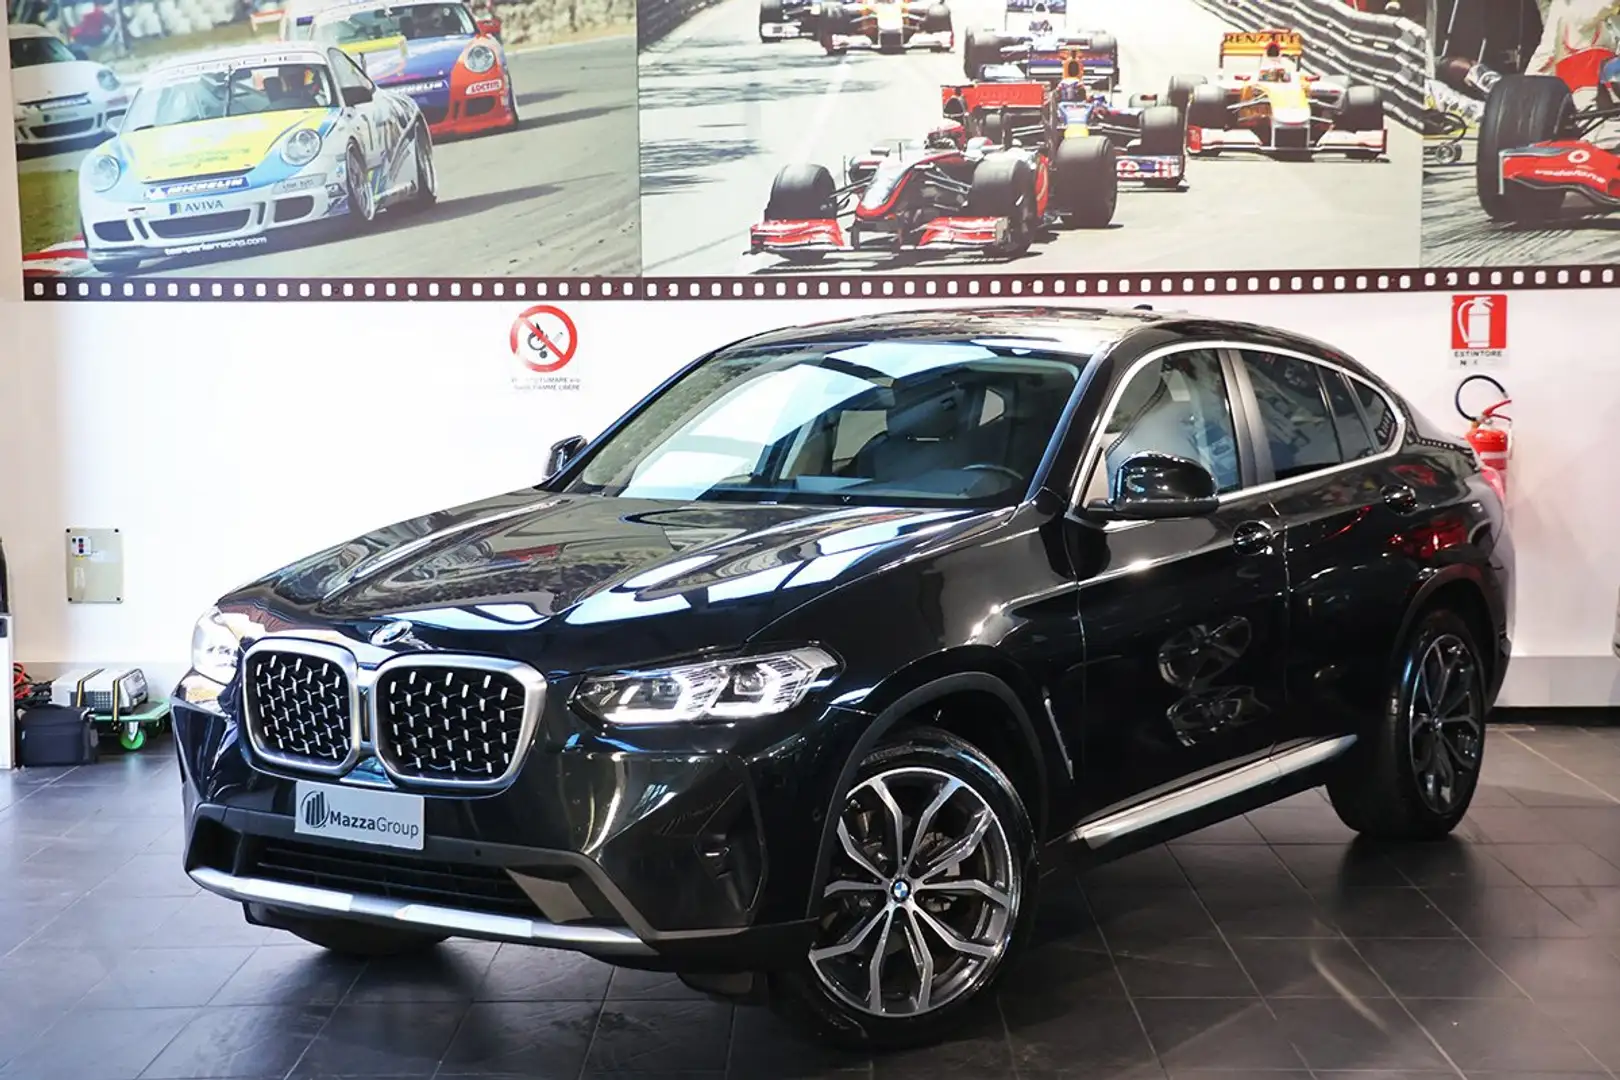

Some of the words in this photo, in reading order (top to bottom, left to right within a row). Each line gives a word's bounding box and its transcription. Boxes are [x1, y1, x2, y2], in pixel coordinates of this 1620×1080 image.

[167, 178, 243, 194] MICHELIN
[184, 200, 224, 212] AVIVA
[329, 810, 420, 839] MazzaGroup
